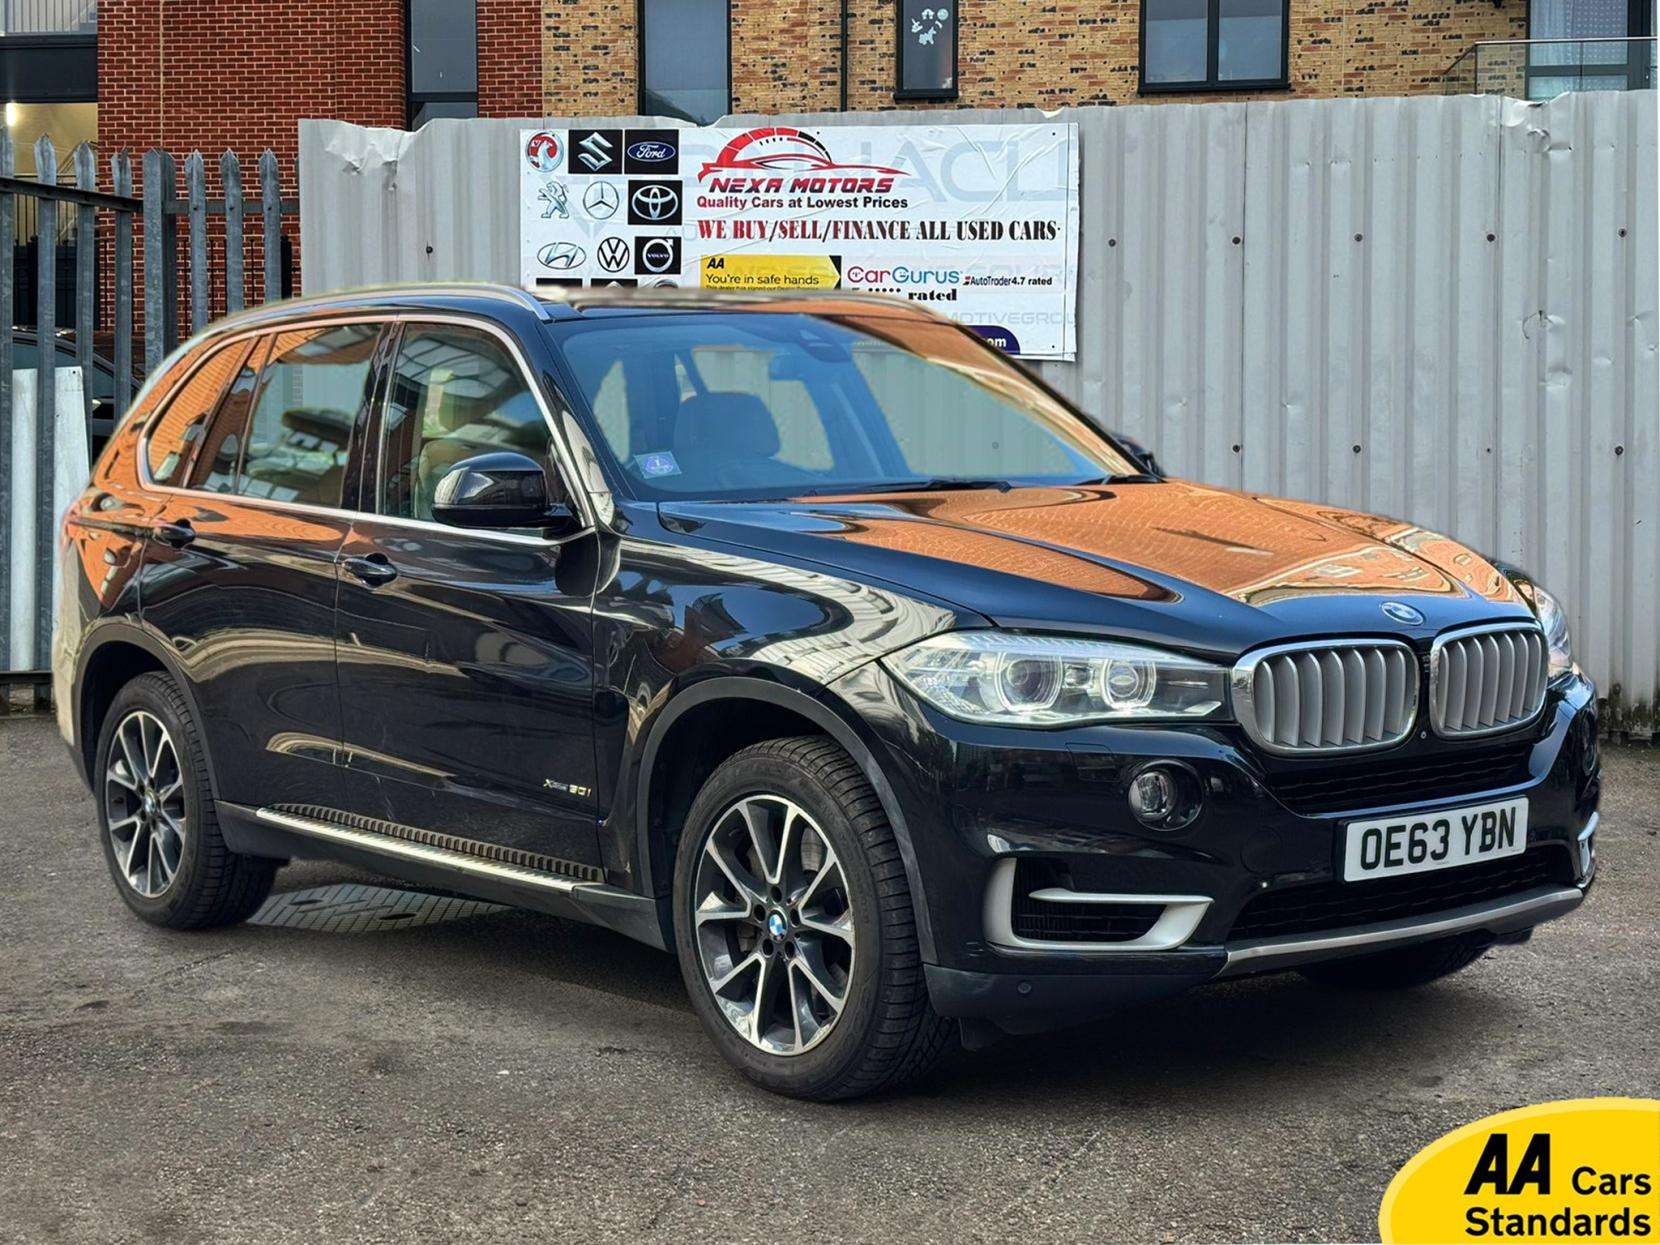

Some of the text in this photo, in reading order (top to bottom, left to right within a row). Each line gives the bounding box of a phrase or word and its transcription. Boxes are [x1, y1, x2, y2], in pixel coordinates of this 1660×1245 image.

[636, 145, 666, 158] Ford
[709, 178, 894, 193] NEXA MOTORS
[697, 196, 908, 210] Quality Cars at Lowest Prices
[697, 220, 726, 239] WE
[733, 220, 910, 242] BUY/SELL/FINANCE
[916, 221, 950, 240] ALL
[957, 221, 1003, 240] USED
[1009, 221, 1057, 240] CARS
[706, 258, 724, 269] AA
[706, 274, 819, 285] You're in safe hands
[847, 266, 959, 284] CarGurus
[1011, 277, 1025, 285] 4.7
[1028, 277, 1052, 285] rated
[908, 289, 957, 300] rated
[1360, 806, 1516, 870] OE63 YBN
